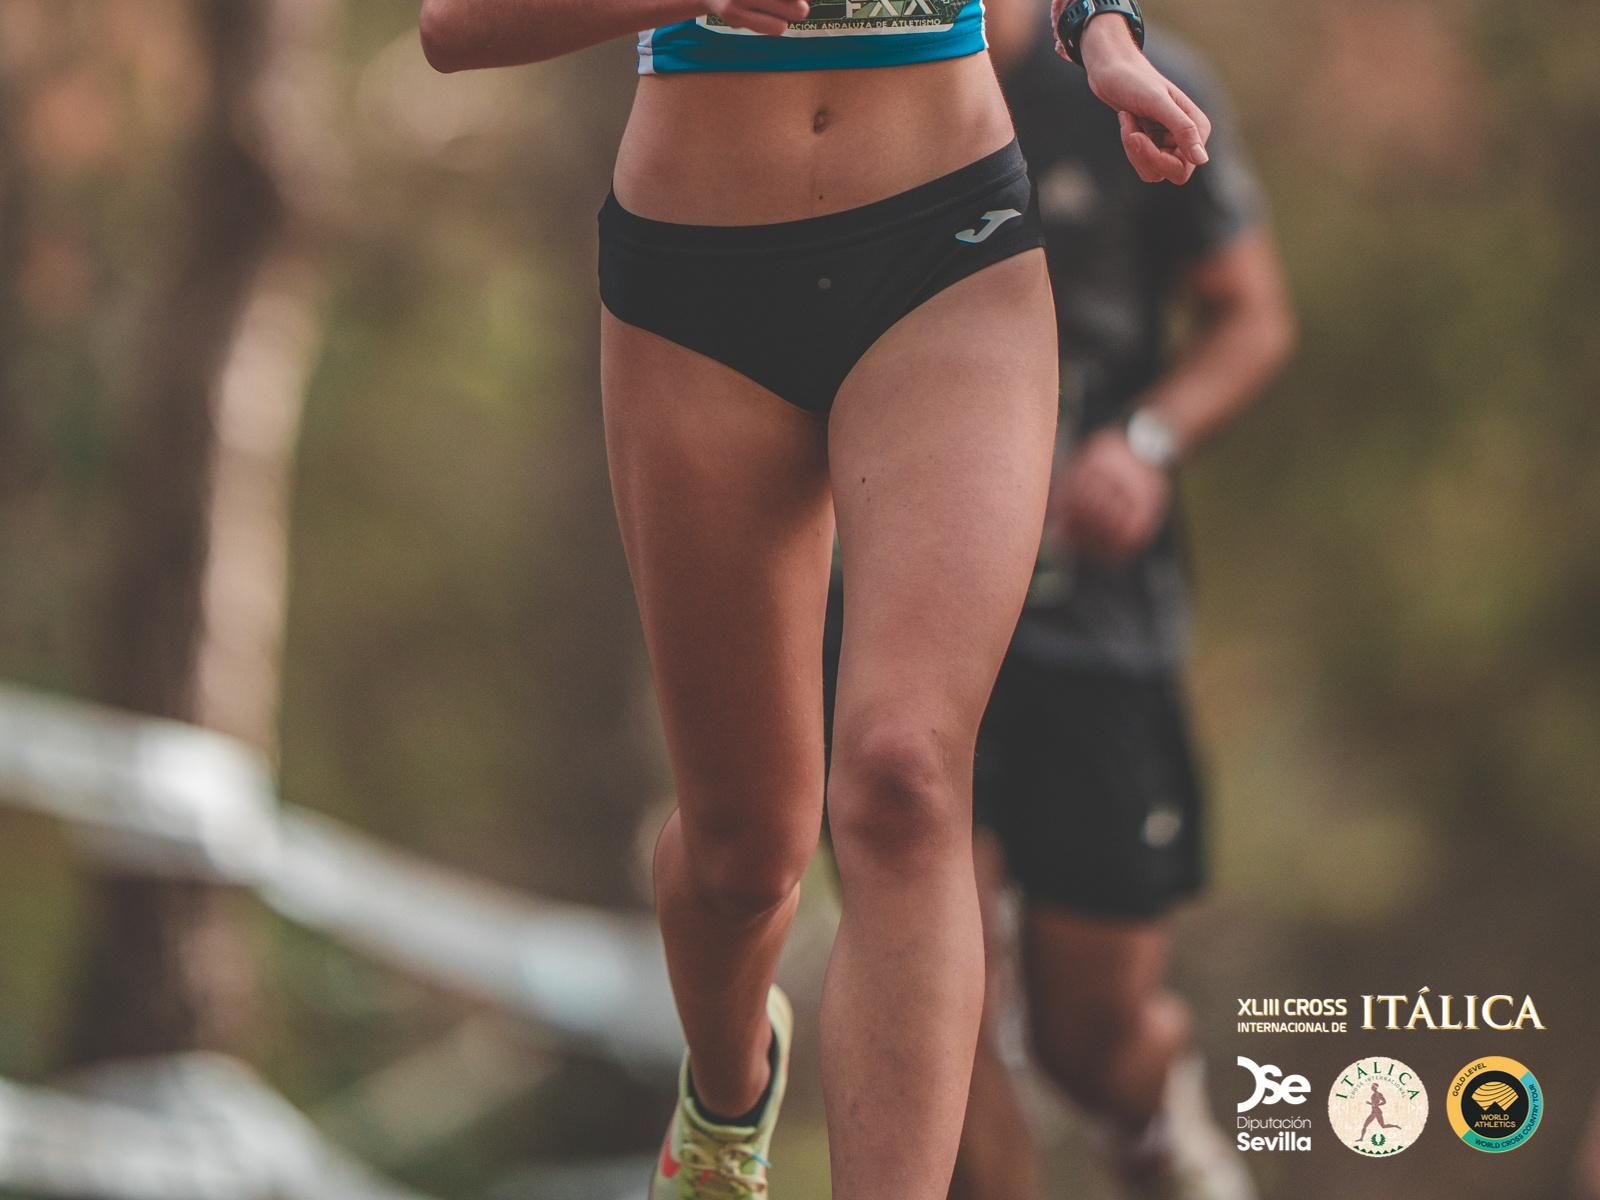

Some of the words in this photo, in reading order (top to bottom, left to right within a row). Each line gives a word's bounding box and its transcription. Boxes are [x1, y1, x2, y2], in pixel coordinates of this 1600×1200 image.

[821, 22, 872, 30] ANDALUZA
[875, 20, 888, 28] DE
[891, 18, 941, 28] ATLETISMO
